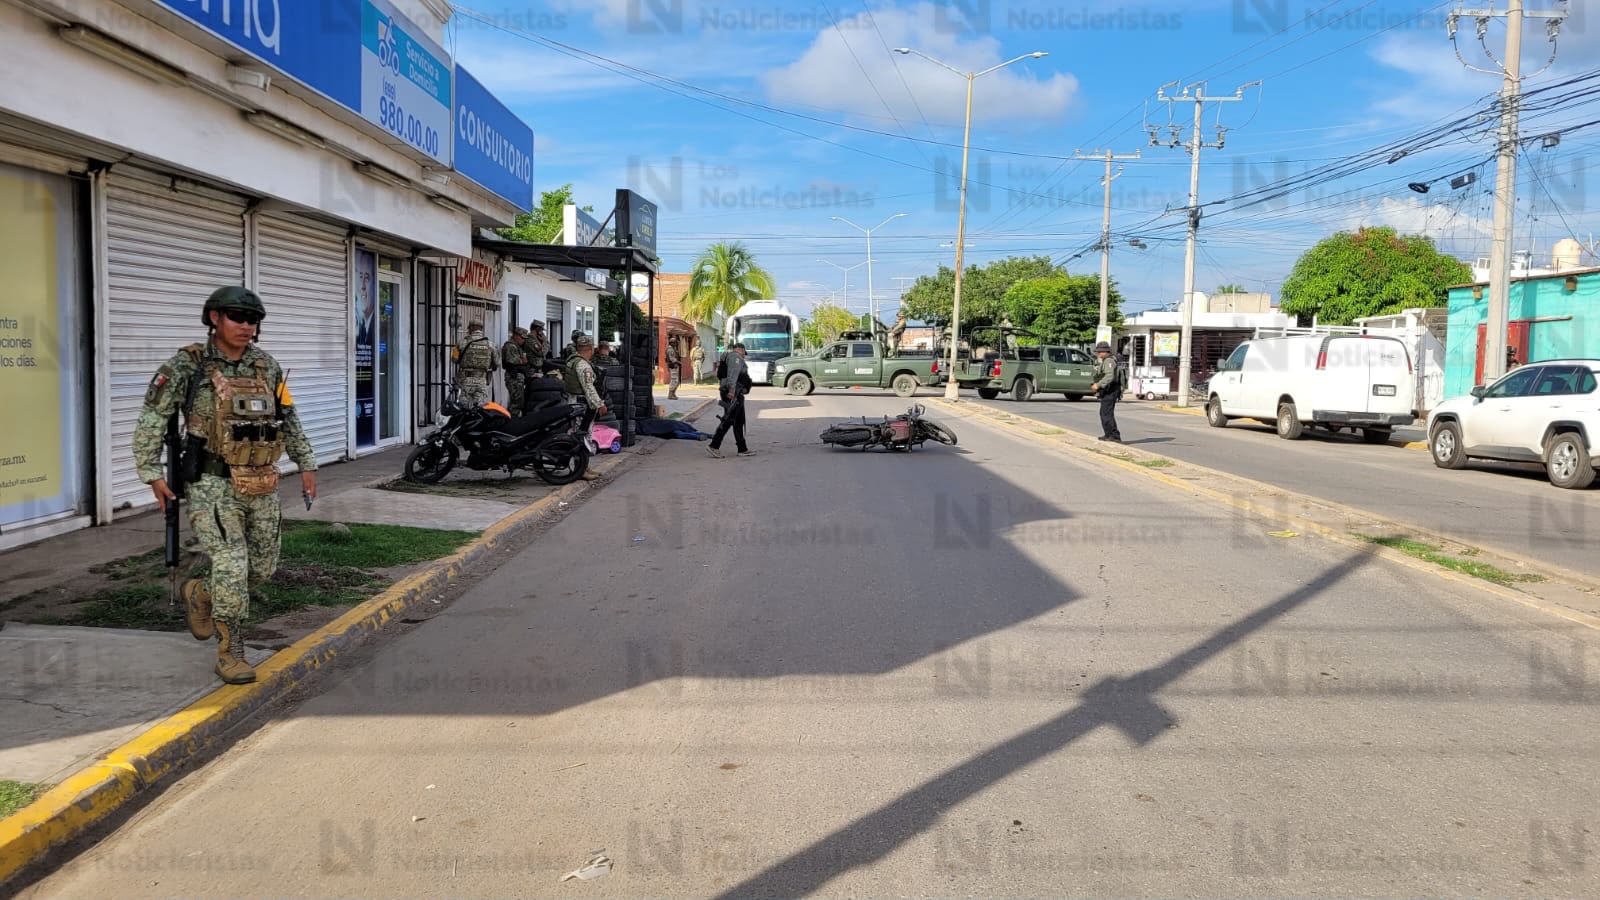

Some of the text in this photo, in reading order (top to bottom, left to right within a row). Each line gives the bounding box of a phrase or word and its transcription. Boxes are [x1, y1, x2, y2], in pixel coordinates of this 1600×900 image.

[406, 41, 435, 78] Servicio
[409, 63, 439, 98] Domicilio
[379, 95, 439, 157] 980.00.00
[459, 104, 531, 184] CONSULTORIO
[0, 338, 32, 348] ciones
